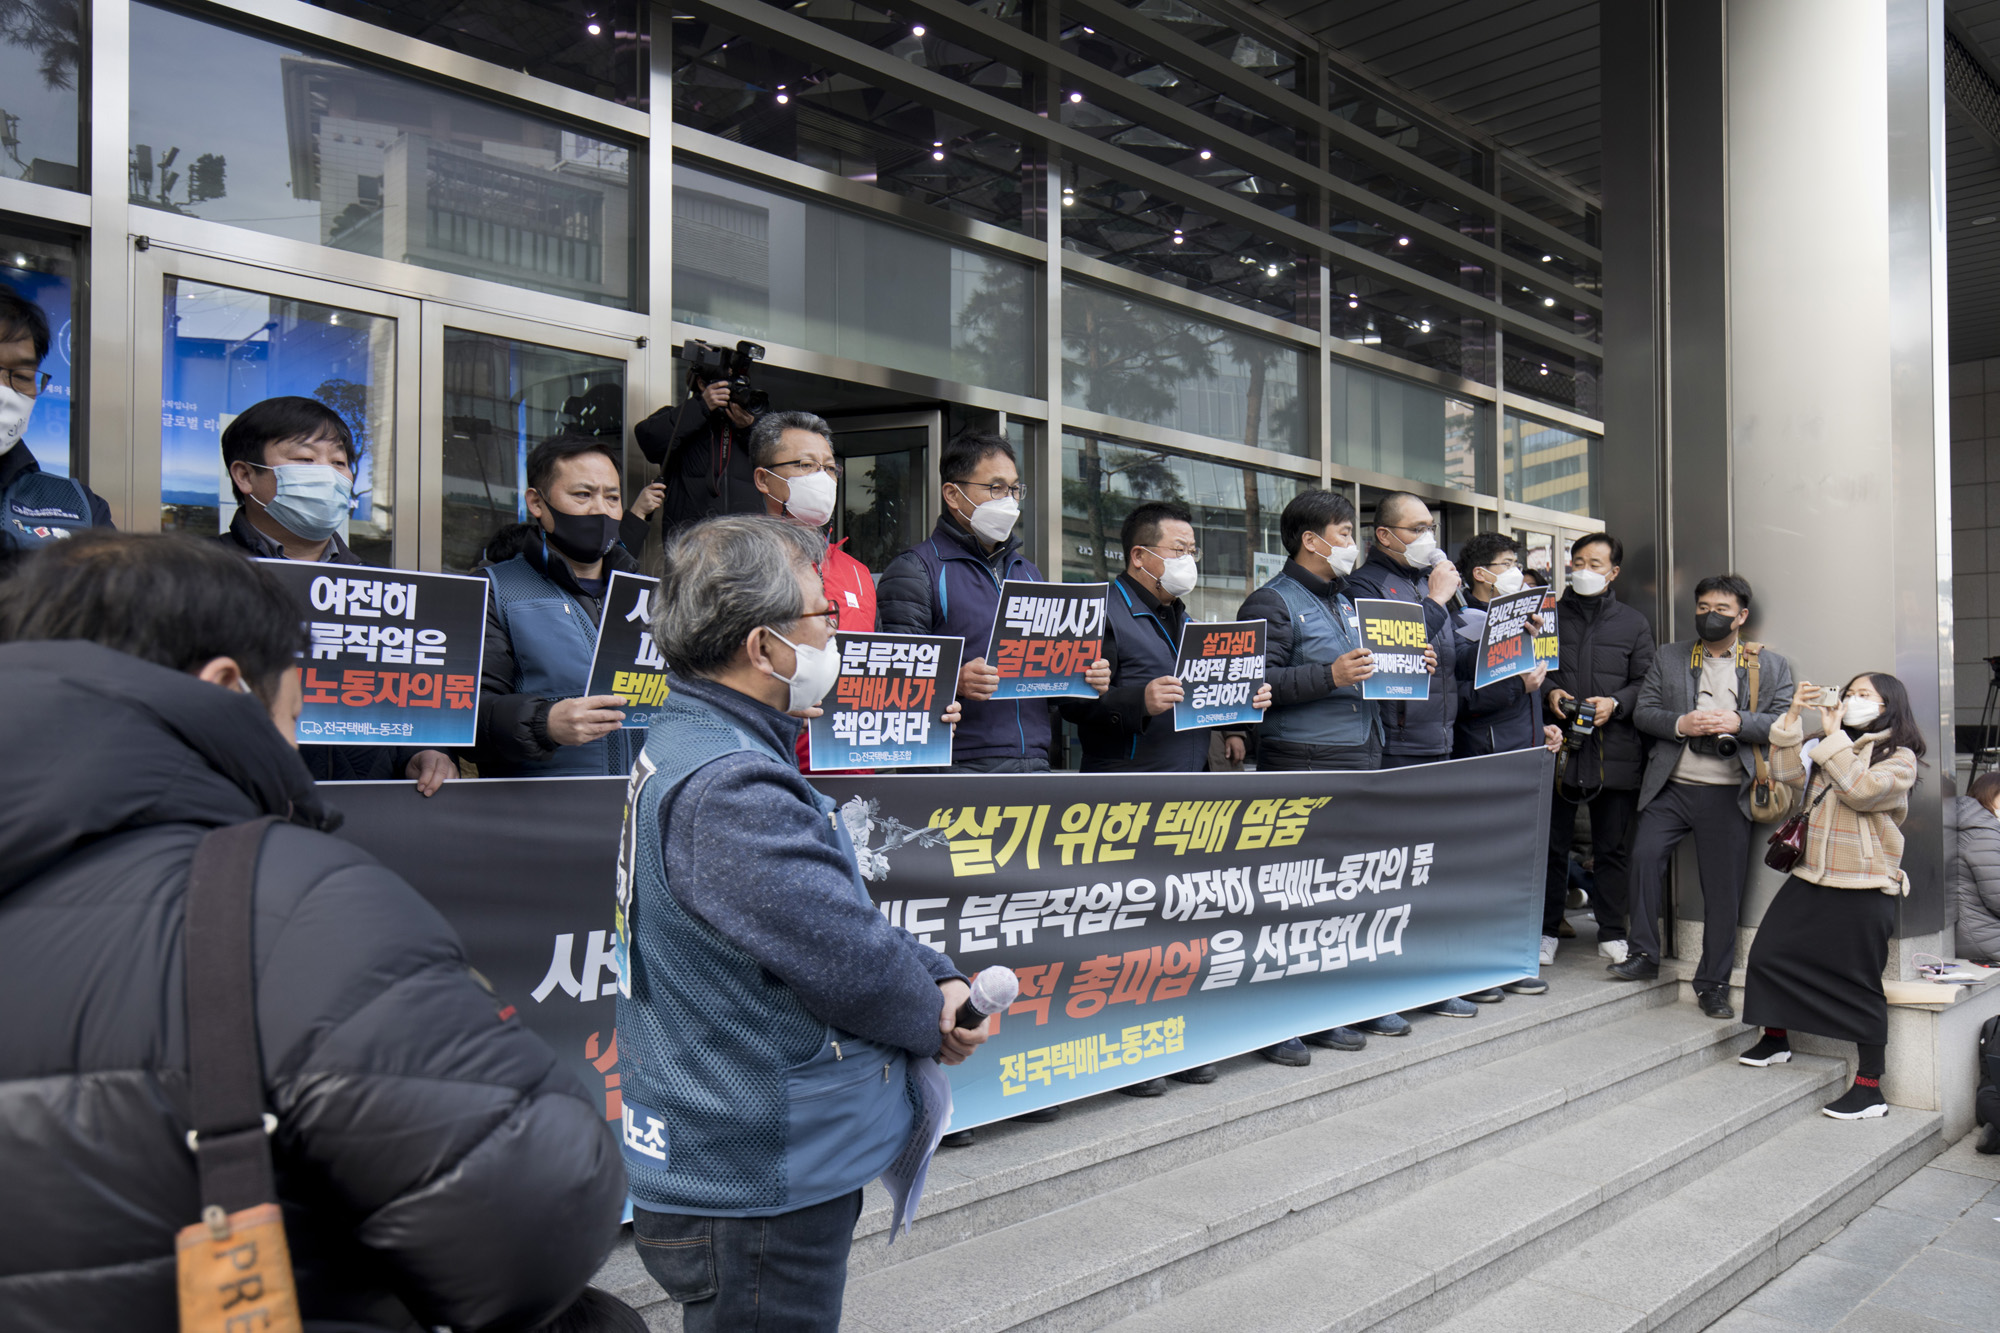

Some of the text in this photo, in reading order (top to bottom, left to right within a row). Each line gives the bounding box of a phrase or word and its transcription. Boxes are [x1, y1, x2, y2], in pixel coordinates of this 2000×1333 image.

[310, 576, 417, 620] 여전히
[1488, 601, 1514, 627] 장시간
[1513, 595, 1541, 616] 무임금
[1005, 596, 1106, 637] 택배사가
[1365, 618, 1427, 648] 국민여러분
[1488, 615, 1527, 646] 분류작업은
[294, 621, 447, 666] 류작업은
[841, 641, 941, 677] 분류작업
[997, 639, 1102, 678] 결단하라
[1202, 630, 1256, 656] 살고싶다
[1487, 635, 1522, 668] 살인이다
[1179, 655, 1264, 683] 사회적 총파업
[297, 667, 475, 710] 노동자의몫
[612, 670, 670, 707] 택배
[836, 677, 936, 710] 택배사가
[1192, 682, 1250, 709] 승리하자
[323, 721, 414, 737] 전국택배노동조합
[832, 711, 931, 746] 책임져라
[861, 751, 912, 762] 전국택배노동조합
[928, 797, 1333, 877] “살기 위한 택배 멈춤”
[531, 843, 1434, 1003] 사 도 분류작업은 여전히 택배노동자의 몫
[968, 962, 1064, 1037] 적
[1249, 903, 1411, 983] 선포합니다
[999, 1015, 1185, 1096] 전국택배노동조합
